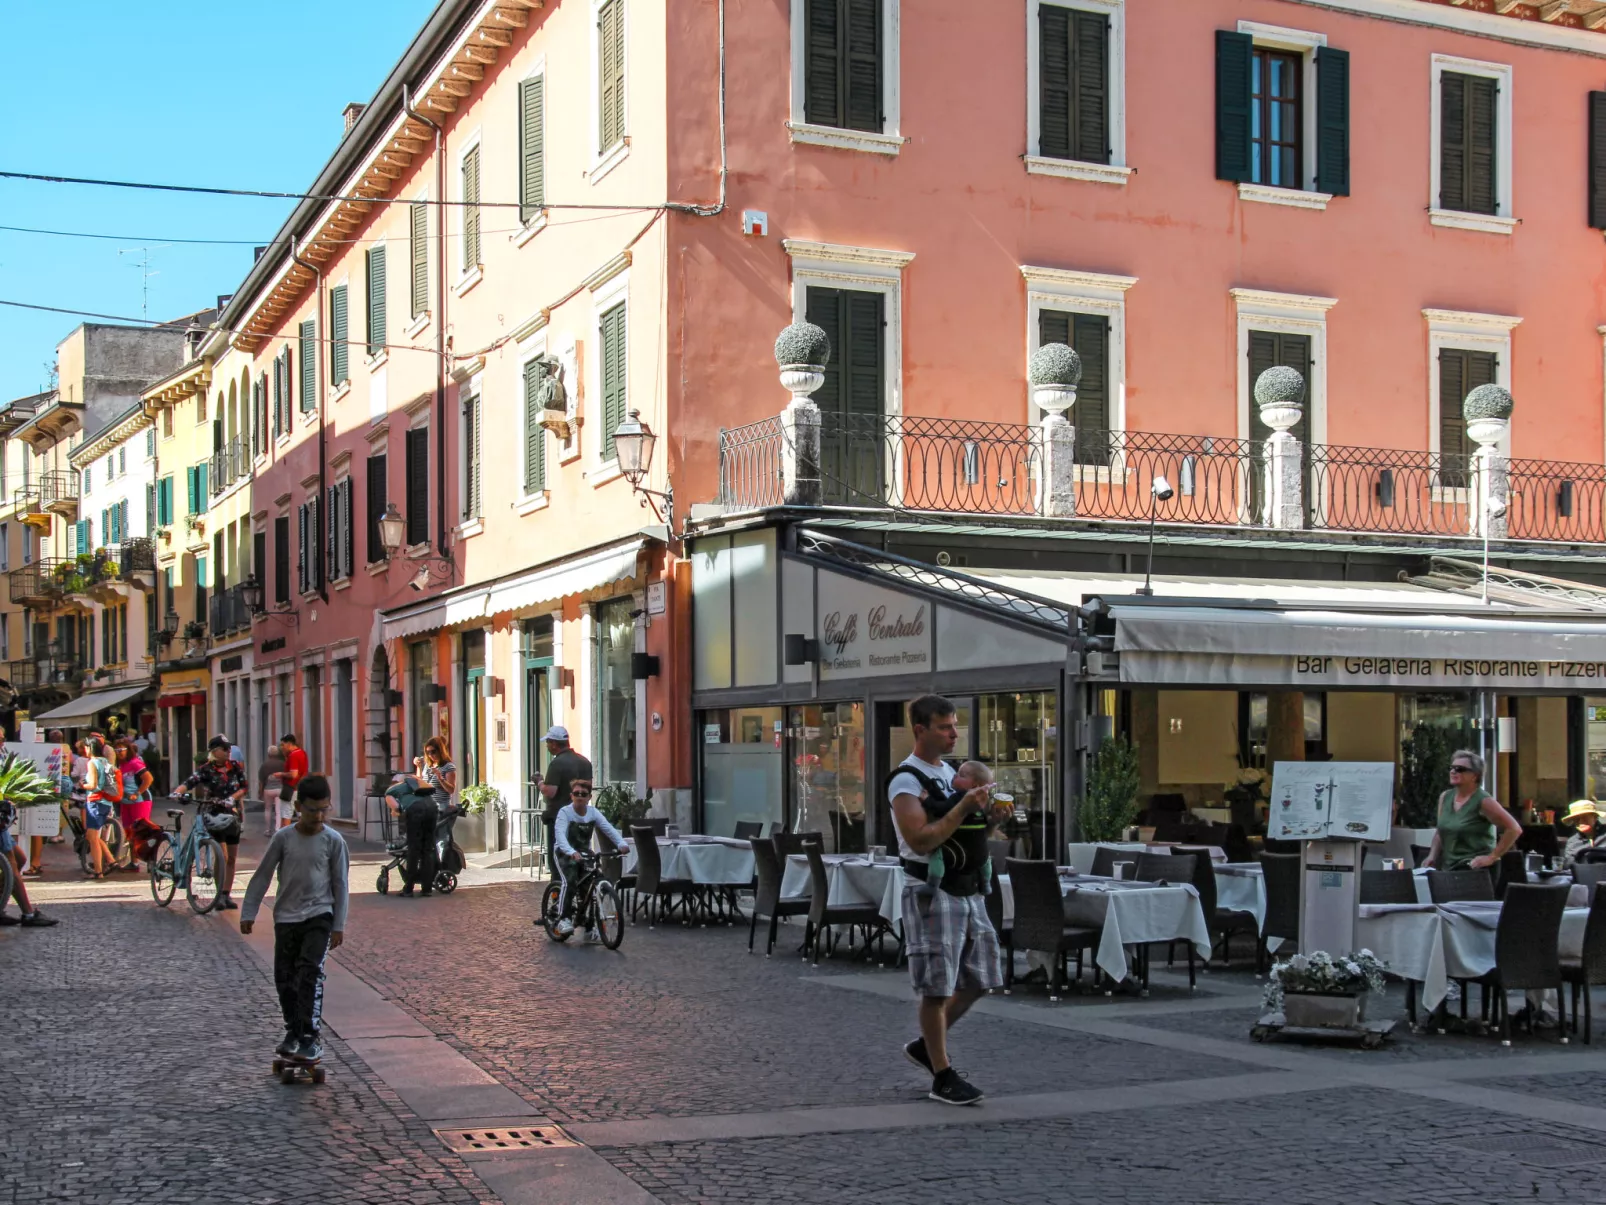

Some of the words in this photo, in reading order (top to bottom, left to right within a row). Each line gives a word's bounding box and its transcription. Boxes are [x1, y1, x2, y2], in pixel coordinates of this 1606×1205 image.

[867, 604, 925, 641] Centrale
[869, 655, 901, 667] Ristorante
[1297, 656, 1332, 674] Bar
[1344, 657, 1432, 676] Gelateria
[1443, 660, 1538, 677] Ristorante
